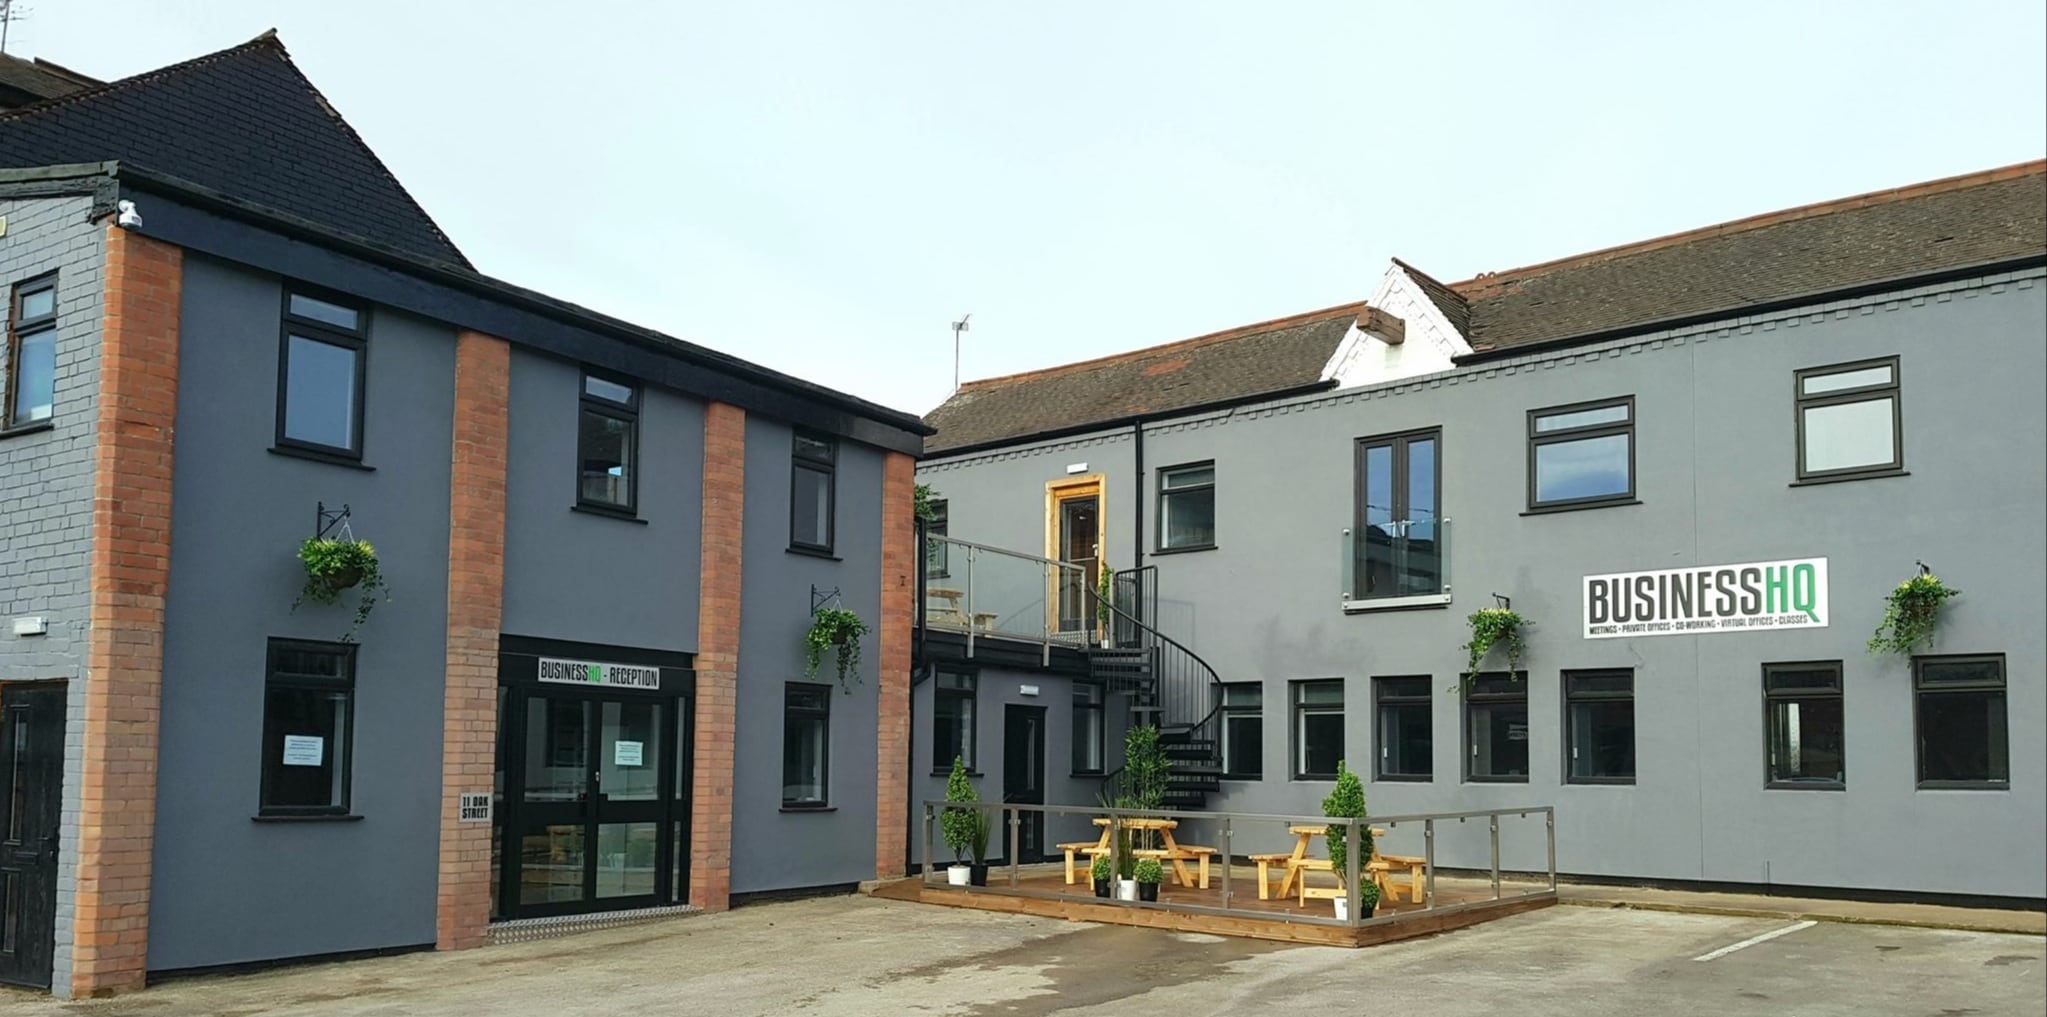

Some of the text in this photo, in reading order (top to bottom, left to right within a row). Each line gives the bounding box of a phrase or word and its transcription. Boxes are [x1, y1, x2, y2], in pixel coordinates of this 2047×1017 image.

[1588, 562, 1821, 624] BUSINESSHQ
[1589, 614, 1808, 635] MEETINGS PRIVATE OFFICES CO-WORKING VIRTUAL OFFICES CLASSES
[540, 660, 602, 683] BUSINESSHQ
[609, 666, 658, 687] RECEPTION
[462, 796, 489, 807] 11 OAK
[462, 807, 489, 819] STREET
